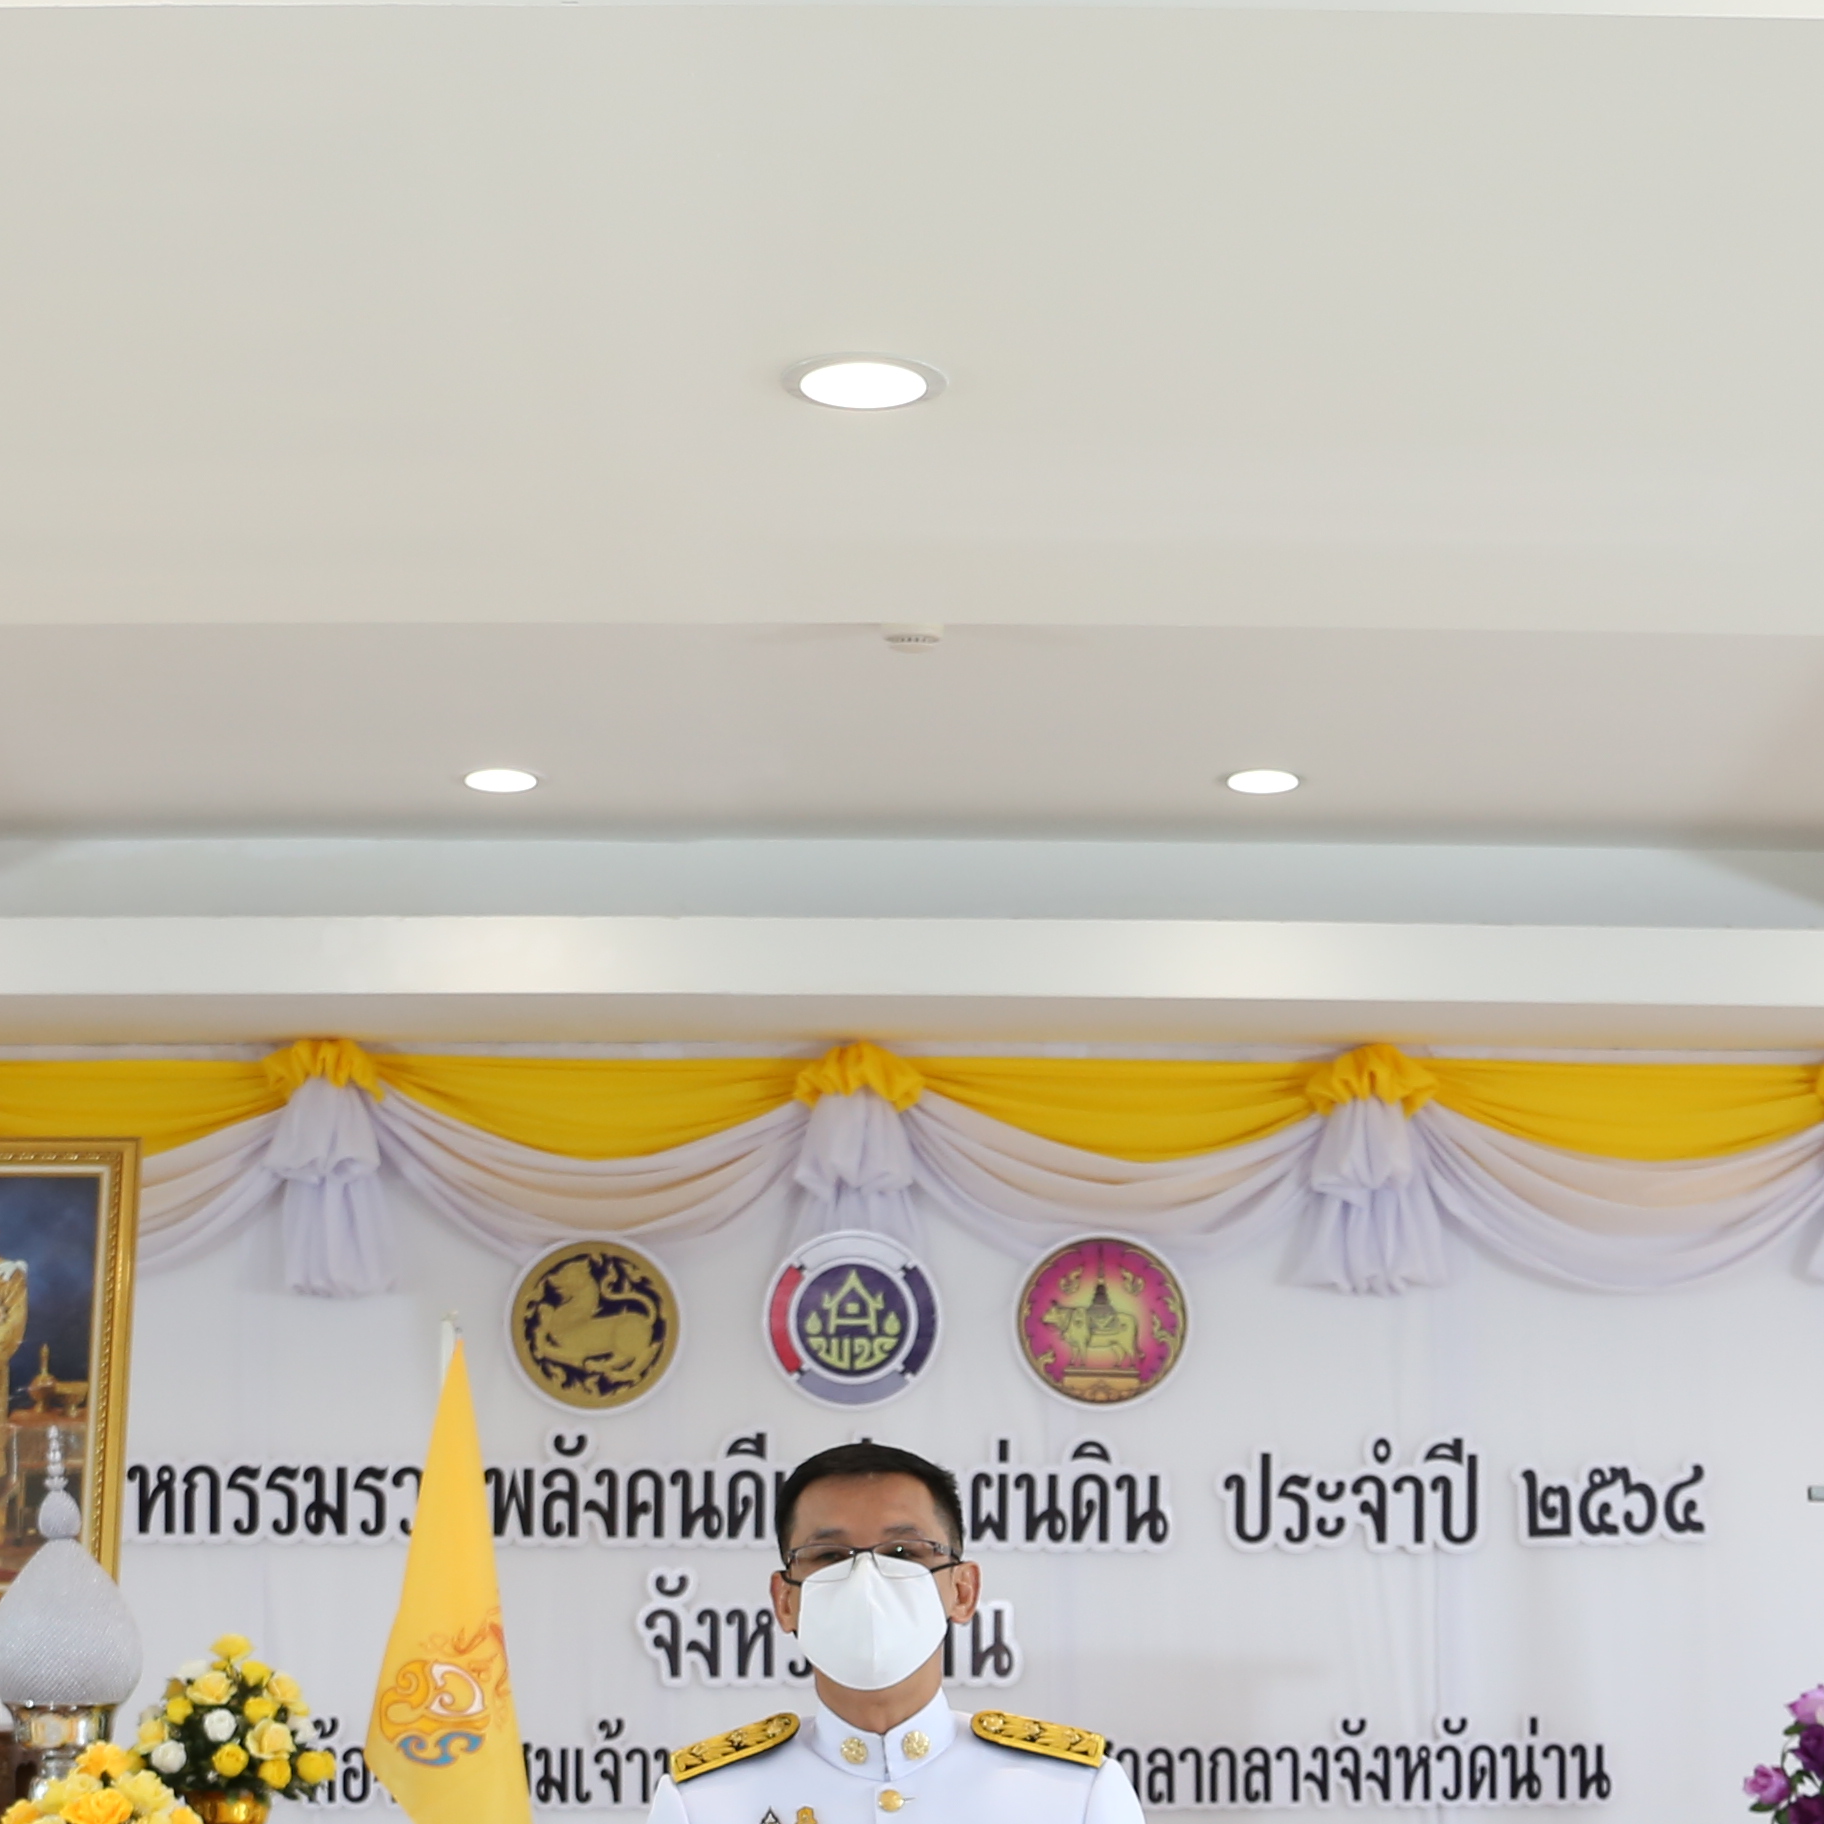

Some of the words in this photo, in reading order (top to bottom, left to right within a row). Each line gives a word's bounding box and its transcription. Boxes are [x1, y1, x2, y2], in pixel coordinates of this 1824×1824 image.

[1223, 1437, 1477, 1544] ประจำปี
[1521, 1464, 1705, 1538] ๒๕๖๔
[1104, 1717, 1611, 1805] าลากลางจังหวัดน่าน
